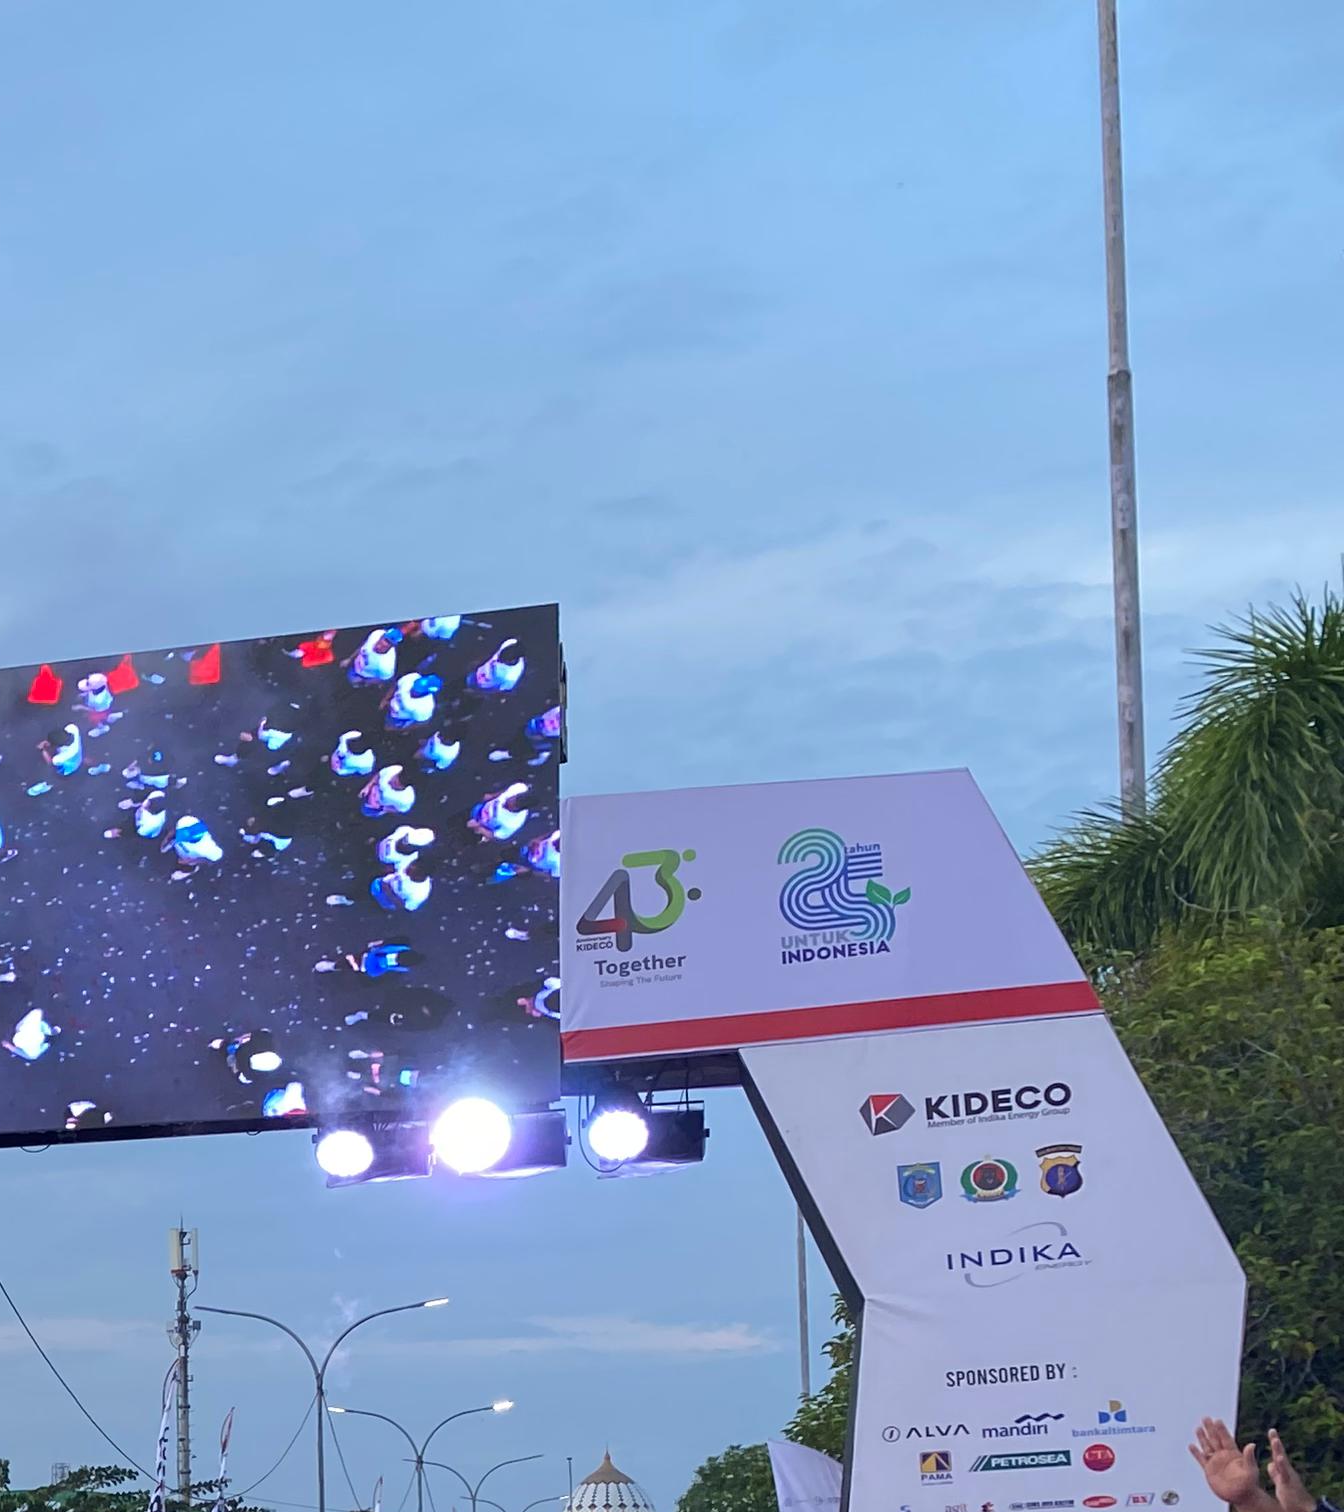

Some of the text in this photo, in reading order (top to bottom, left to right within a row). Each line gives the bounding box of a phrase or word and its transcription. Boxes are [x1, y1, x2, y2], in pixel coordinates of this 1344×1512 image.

[844, 843, 881, 854] tahun
[576, 941, 613, 952] KIDECO
[781, 929, 850, 949] UNTUK
[782, 940, 891, 964] INDONESIA
[594, 955, 686, 977] Together
[636, 976, 652, 984] The
[654, 974, 683, 983] Future
[925, 1082, 1072, 1120] KIDECO
[1041, 1107, 1070, 1116] Group
[947, 1242, 1081, 1270] INDIKA
[946, 1365, 1040, 1387] SPONSORED
[1046, 1363, 1066, 1380] BY
[906, 1424, 970, 1439] ALVA
[982, 1422, 1049, 1439] mandiri
[990, 1453, 1068, 1468] PETROSEA
[921, 1473, 953, 1481] PAMA
